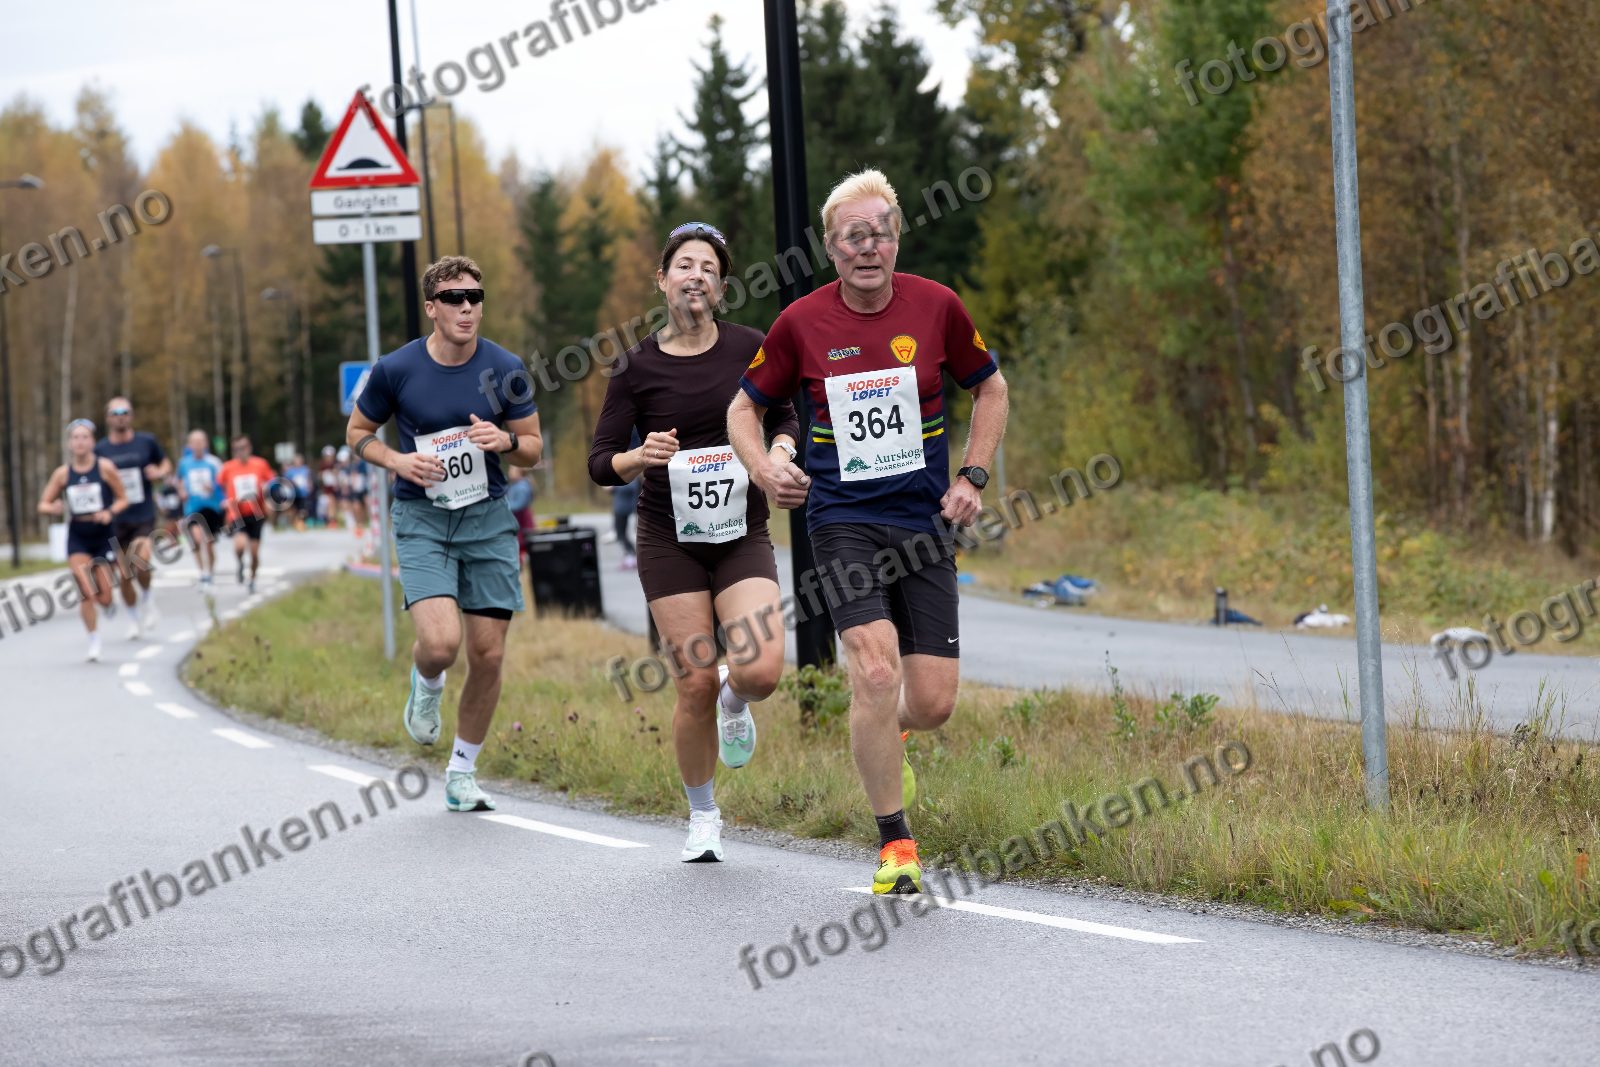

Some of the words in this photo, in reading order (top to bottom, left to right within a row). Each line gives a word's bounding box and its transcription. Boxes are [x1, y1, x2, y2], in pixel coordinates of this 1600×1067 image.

[333, 195, 398, 210] Gangfelt
[338, 224, 349, 237] 0
[373, 222, 397, 235] km
[847, 376, 900, 391] NORGES
[852, 387, 892, 401] LØPET
[848, 404, 905, 441] 364
[432, 431, 469, 445] NORGES
[436, 439, 464, 452] LØPET
[688, 453, 733, 464] NORGES
[874, 448, 922, 465] Aurskog
[691, 462, 727, 474] LØPET
[688, 478, 735, 509] 557
[708, 518, 744, 532] Aurskog
